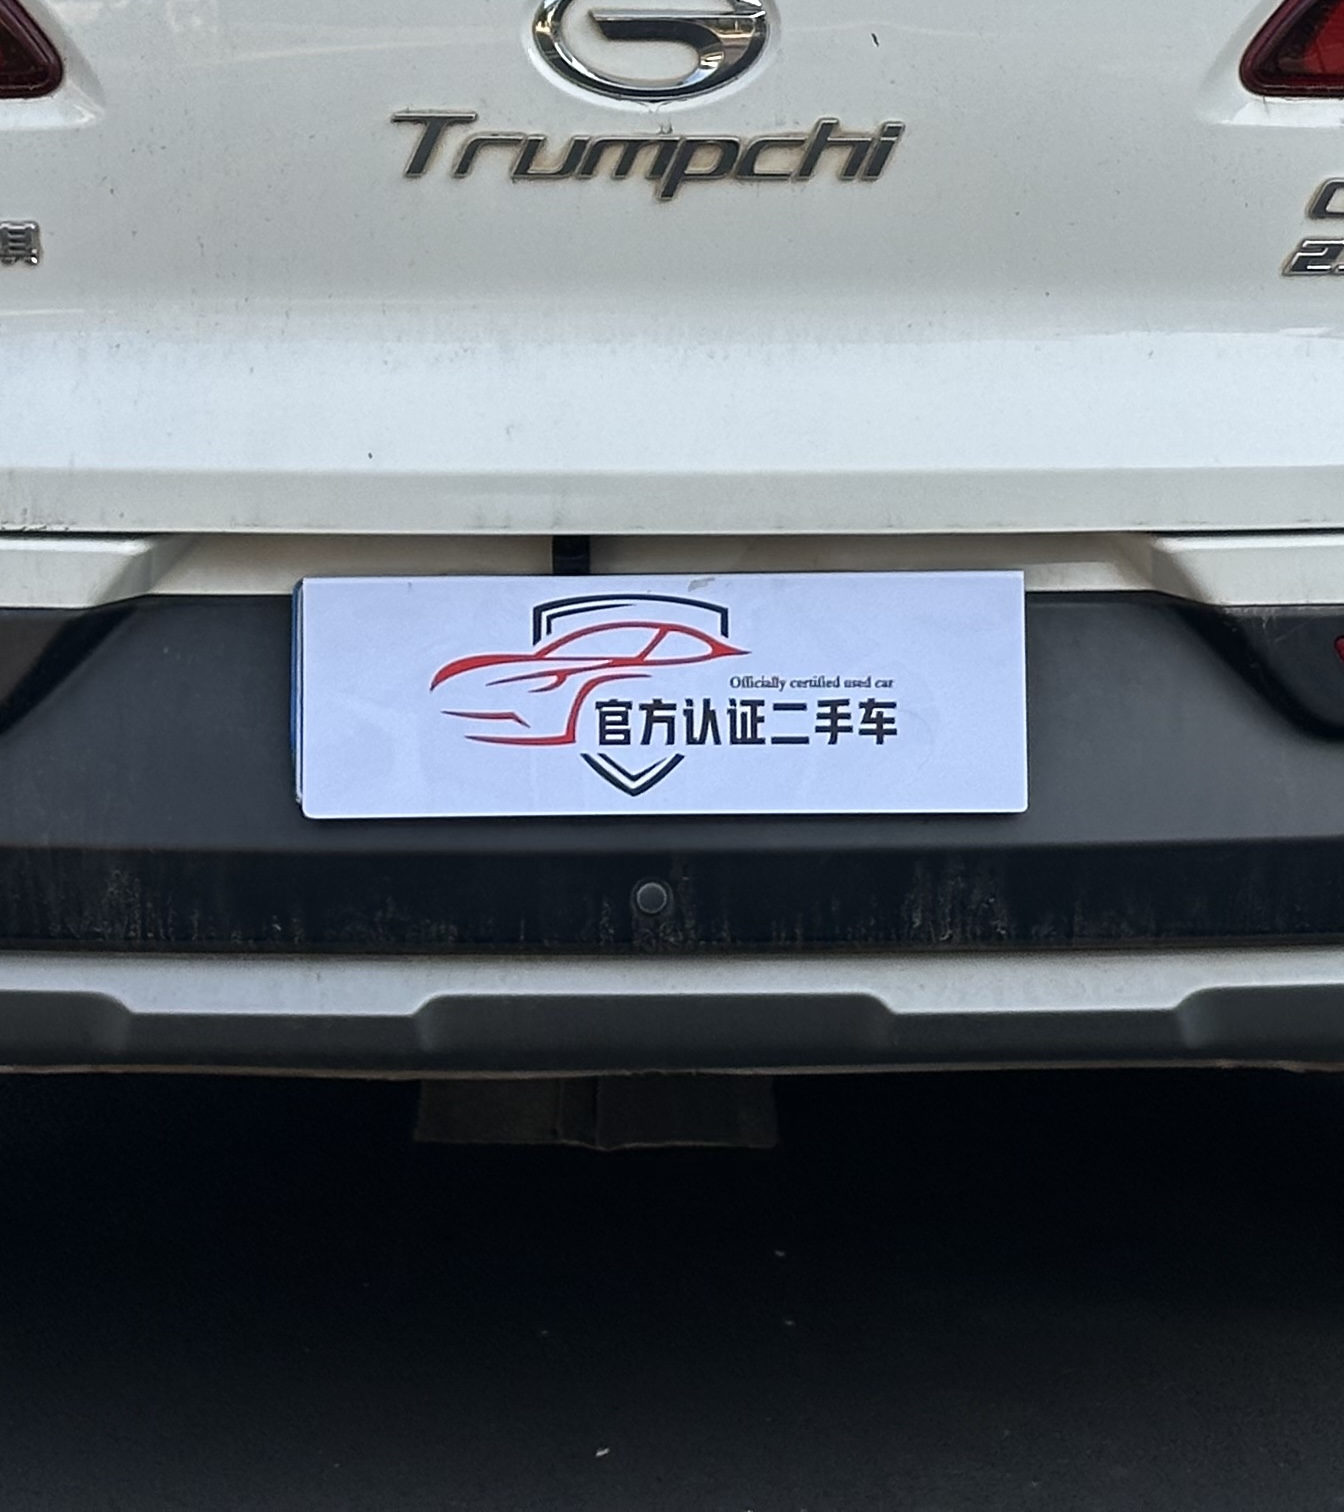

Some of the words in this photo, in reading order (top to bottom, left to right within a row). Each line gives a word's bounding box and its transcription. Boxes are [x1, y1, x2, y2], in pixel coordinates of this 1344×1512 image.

[391, 110, 906, 201] Trumpchi
[729, 675, 786, 692] Officially
[789, 675, 841, 689] certified
[844, 675, 871, 689] used
[874, 678, 894, 689] car
[595, 697, 898, 746] 官方认证二手车
